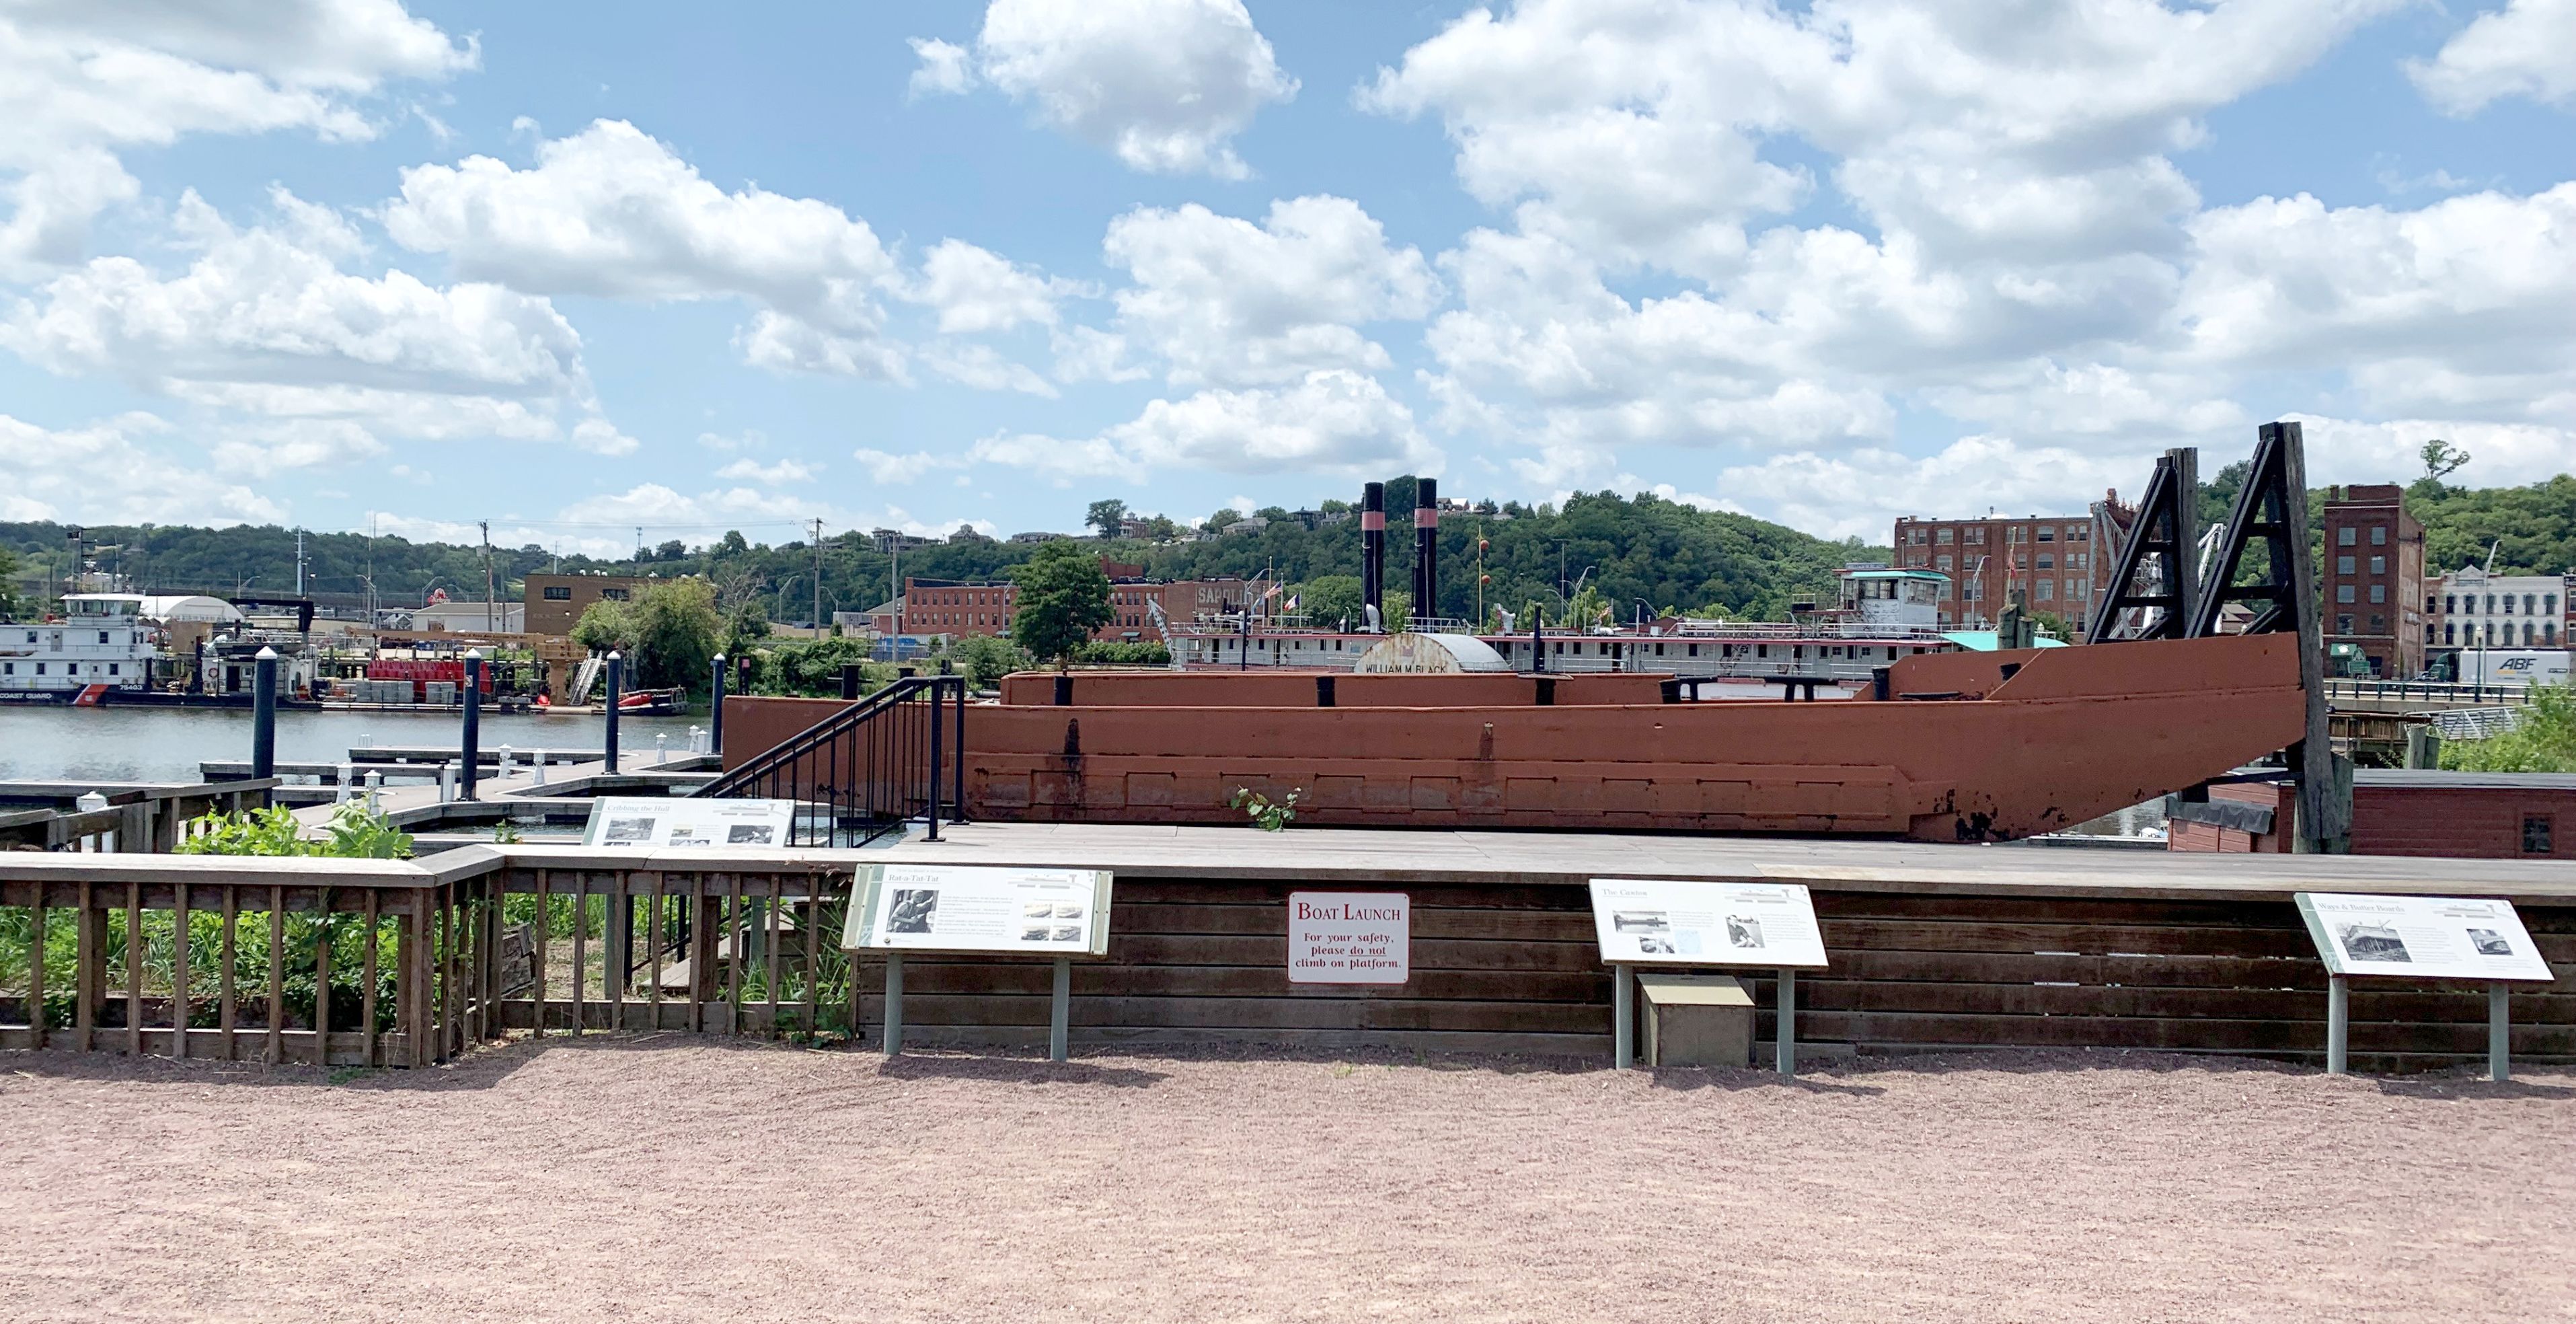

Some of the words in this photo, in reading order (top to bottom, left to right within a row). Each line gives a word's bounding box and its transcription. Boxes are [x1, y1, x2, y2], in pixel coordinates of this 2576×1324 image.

[1366, 664, 1401, 673] WILLIAM
[1415, 664, 1445, 673] BLACK
[2499, 658, 2537, 670] ABF
[607, 805, 639, 813] Cribbing
[1297, 902, 1339, 920] BOAT
[1344, 904, 1401, 921] LAUNCH
[2318, 903, 2339, 911] Ways
[1304, 932, 1322, 942] For
[1327, 934, 1353, 944] your
[1357, 932, 1394, 944] safety,
[1311, 946, 1345, 957] please
[1350, 946, 1364, 955] do
[1369, 947, 1386, 955] not
[1295, 959, 1326, 968] climb
[1349, 959, 1402, 970] platform.
